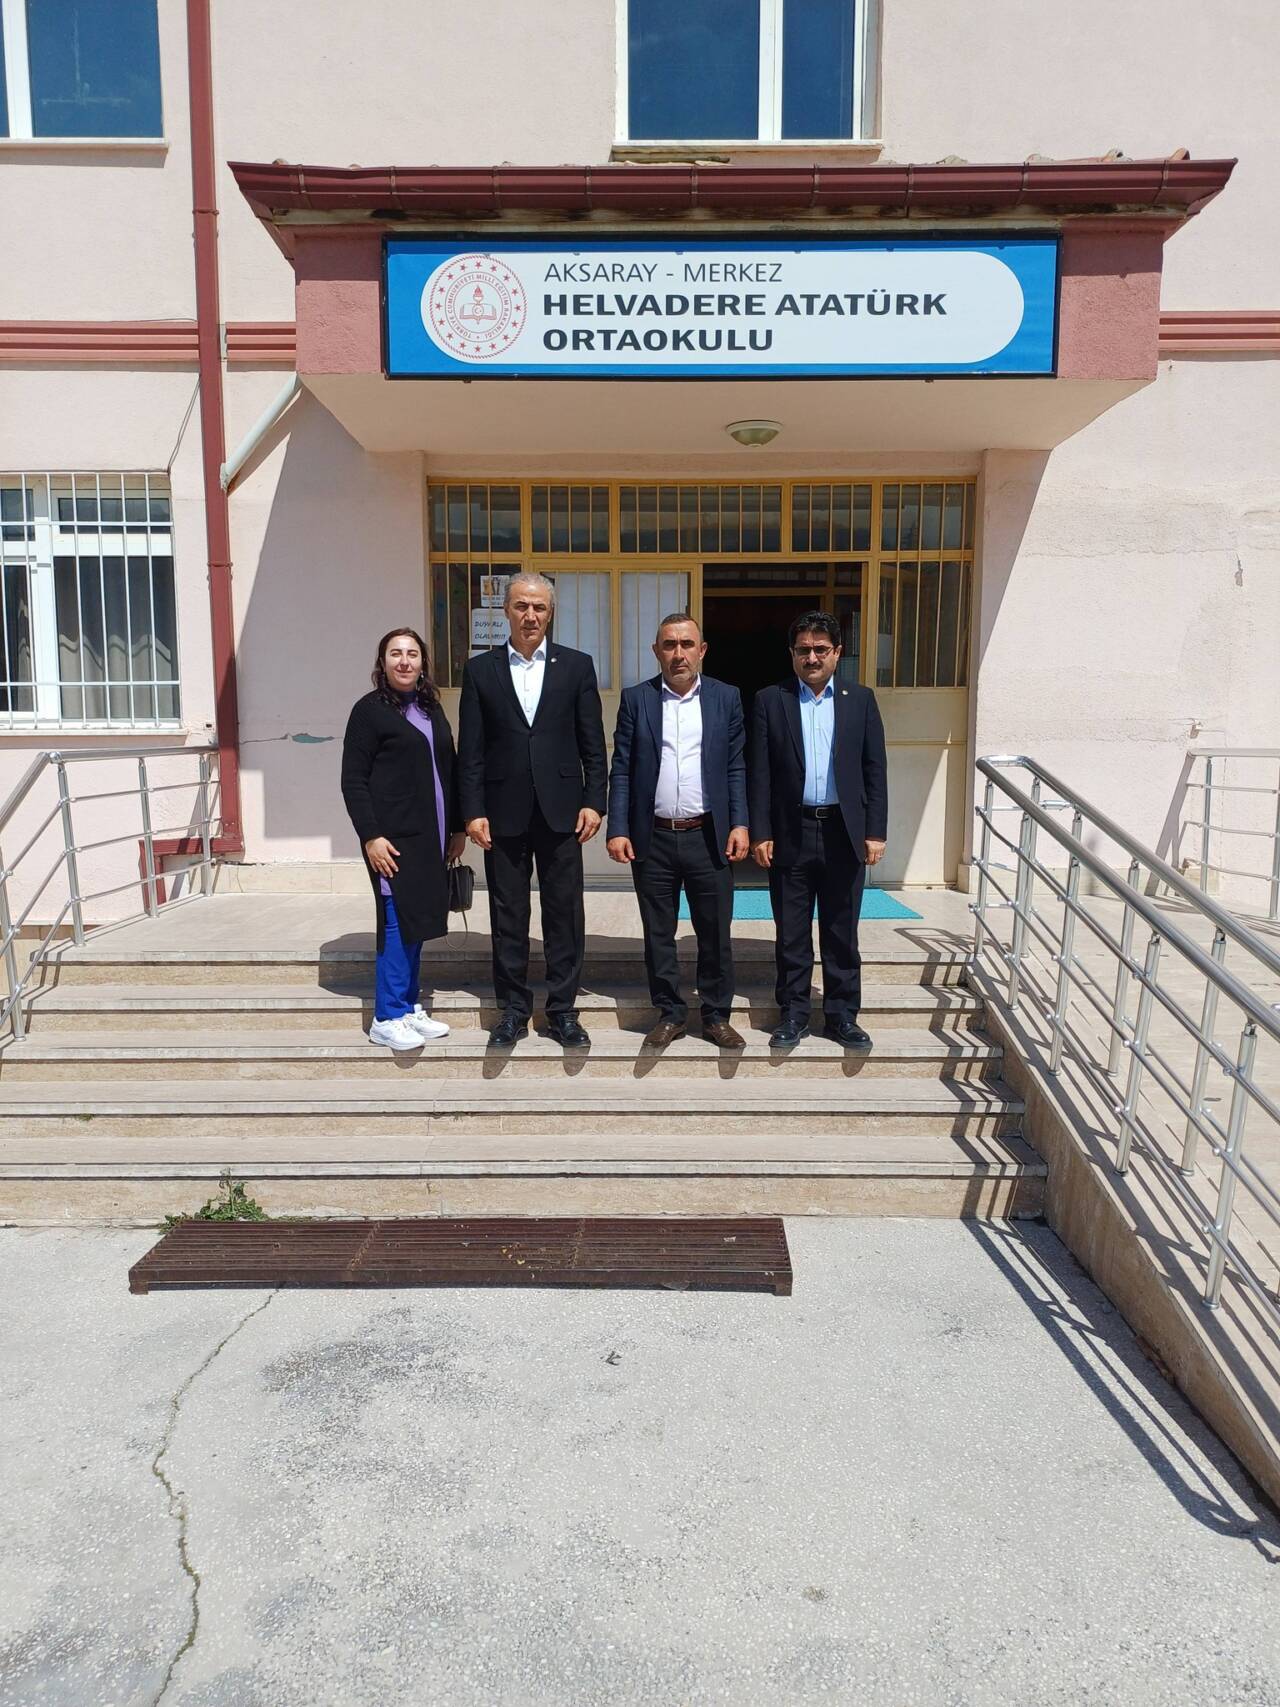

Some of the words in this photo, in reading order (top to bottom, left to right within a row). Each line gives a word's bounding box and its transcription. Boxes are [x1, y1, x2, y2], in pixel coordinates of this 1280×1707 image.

[544, 263, 658, 283] AKSARAY
[684, 263, 783, 283] MERKEZ
[543, 294, 766, 316] HELVADERE
[774, 288, 947, 316] ATATÜRK
[542, 328, 773, 351] ORTAOKULU
